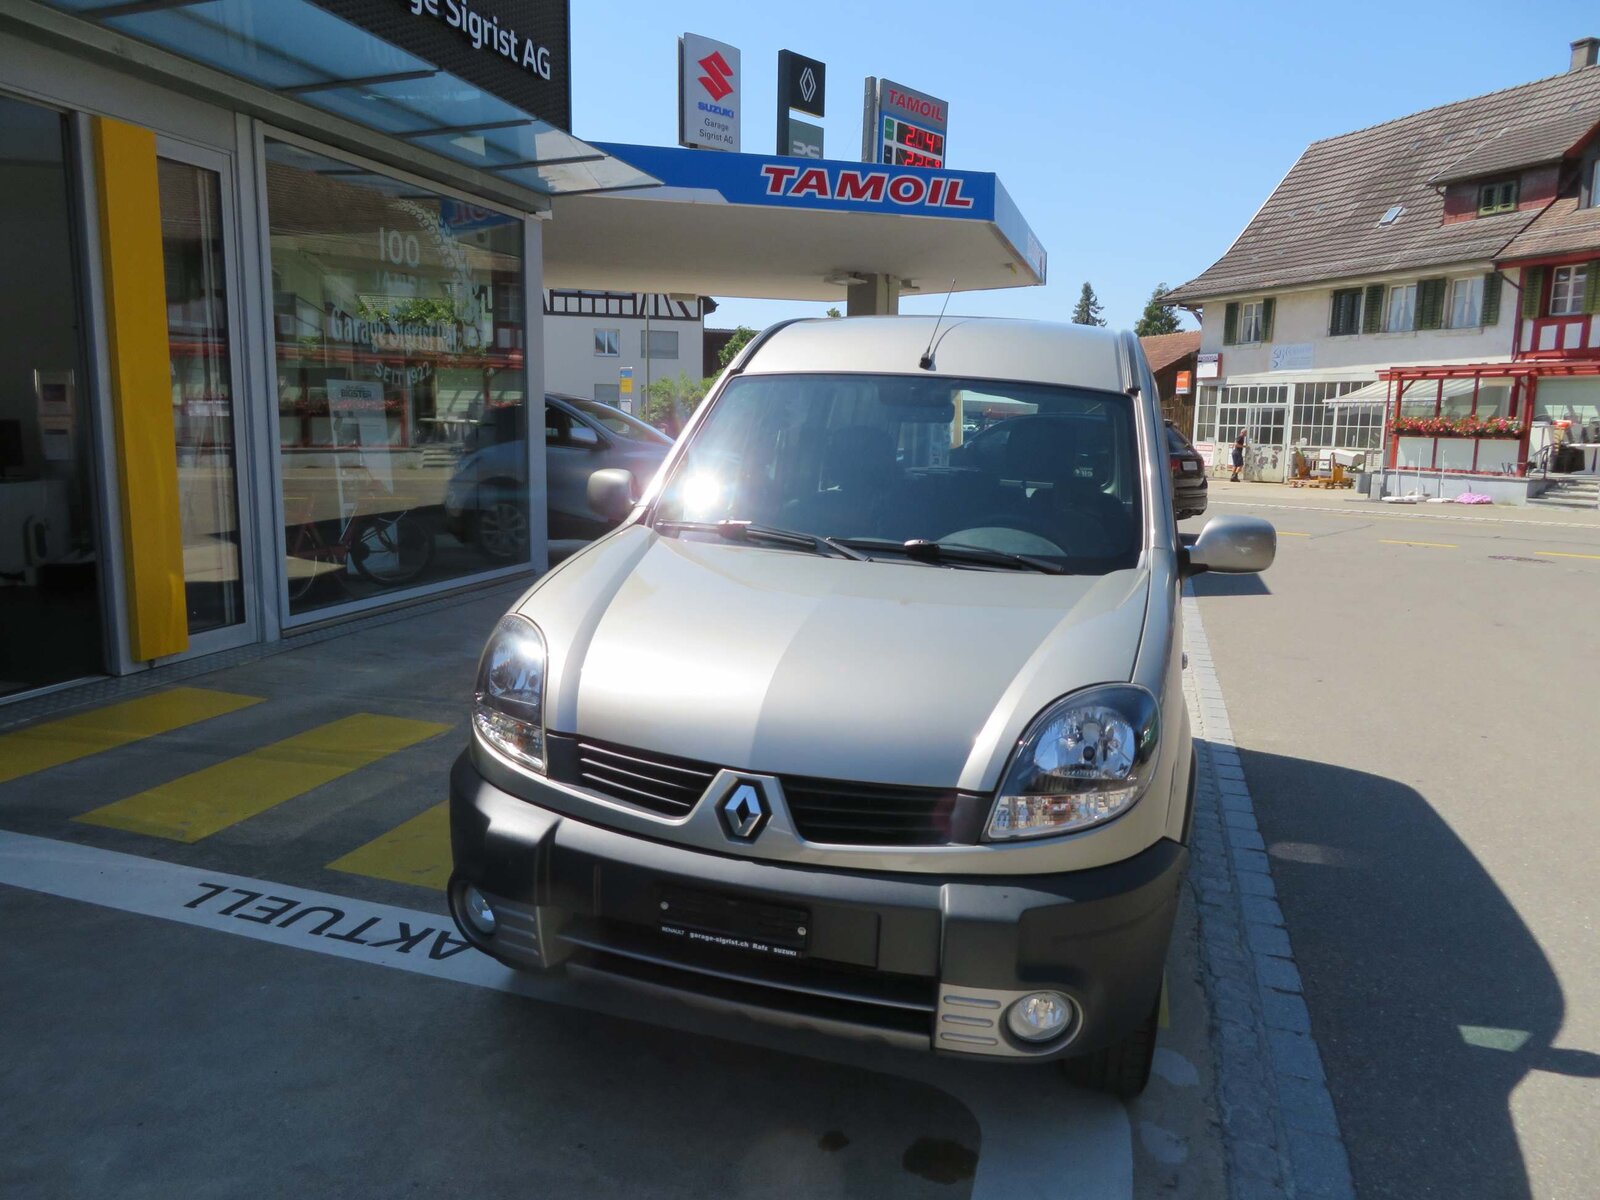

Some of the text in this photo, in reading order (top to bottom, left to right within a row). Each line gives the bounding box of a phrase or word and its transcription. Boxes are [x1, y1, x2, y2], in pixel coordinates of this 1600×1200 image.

[446, 0, 518, 63] Sigrist
[522, 38, 551, 81] AG
[697, 101, 735, 119] SUZUKI
[888, 89, 943, 121] TAMOIL
[699, 128, 734, 145] Sigrist AG
[704, 117, 729, 132] Garage
[760, 163, 975, 210] TAMOIL
[379, 226, 420, 268] 100
[330, 308, 386, 354] Garage
[389, 307, 434, 356] Sigrist
[374, 361, 433, 385] SEIT 1922
[183, 882, 474, 961] AKTUELL
[661, 925, 685, 936] RENAULT
[689, 932, 749, 948] garage-sigrist.ch
[773, 947, 797, 956] SUZUKI
